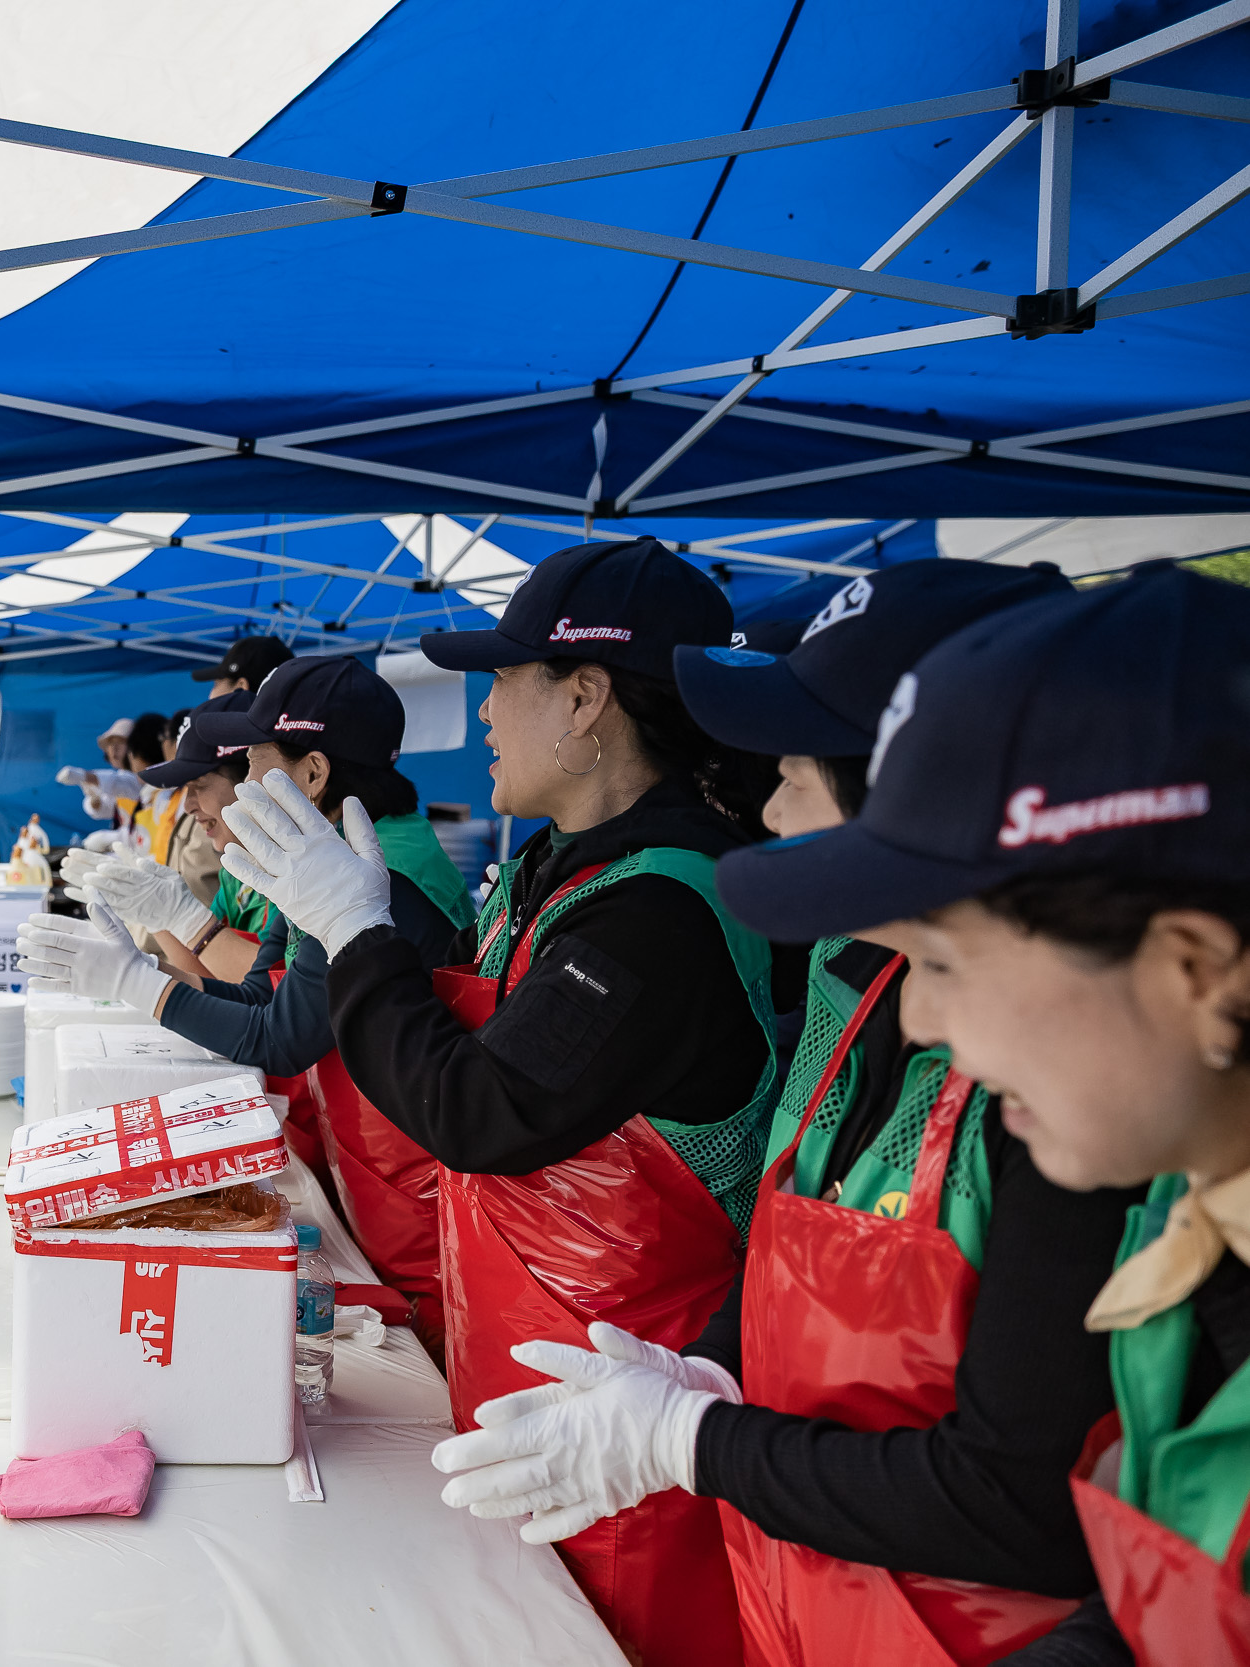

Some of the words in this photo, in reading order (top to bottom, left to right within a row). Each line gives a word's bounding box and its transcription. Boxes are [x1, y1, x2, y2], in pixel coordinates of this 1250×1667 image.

[549, 617, 632, 643] Superman
[274, 713, 326, 731] Superman
[998, 785, 1211, 848] Superman
[564, 962, 586, 980] Jeep
